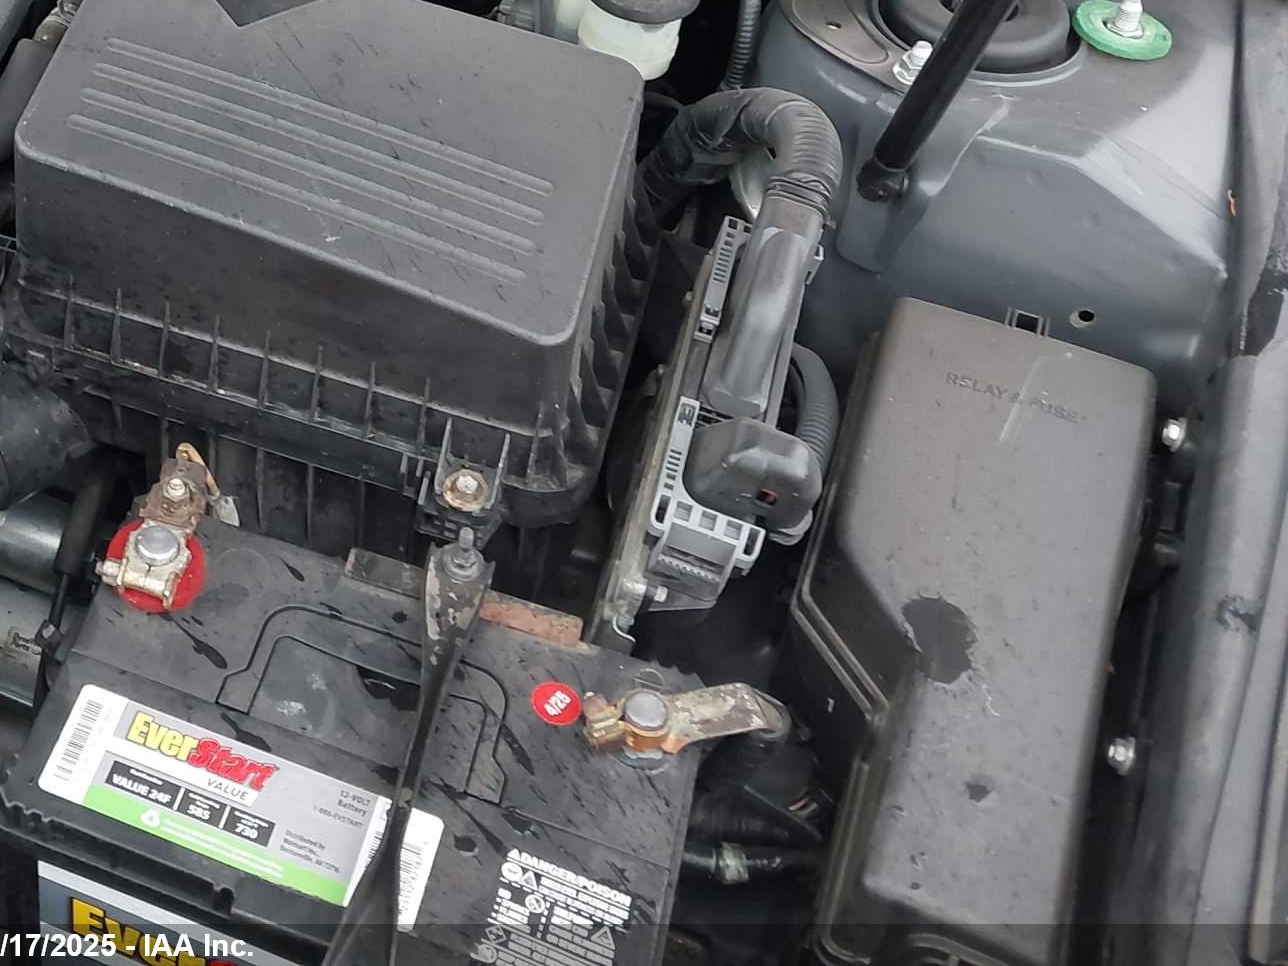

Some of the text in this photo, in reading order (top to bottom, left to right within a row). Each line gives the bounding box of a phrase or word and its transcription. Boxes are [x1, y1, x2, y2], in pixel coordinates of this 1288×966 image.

[945, 371, 1009, 401] RELAY
[1029, 396, 1080, 425] FUSE
[126, 711, 277, 792] EverStart
[111, 773, 150, 797] VALUE
[149, 788, 173, 805] 24F
[207, 777, 250, 802] VALUE
[186, 805, 212, 821] 585
[234, 822, 260, 840] 730
